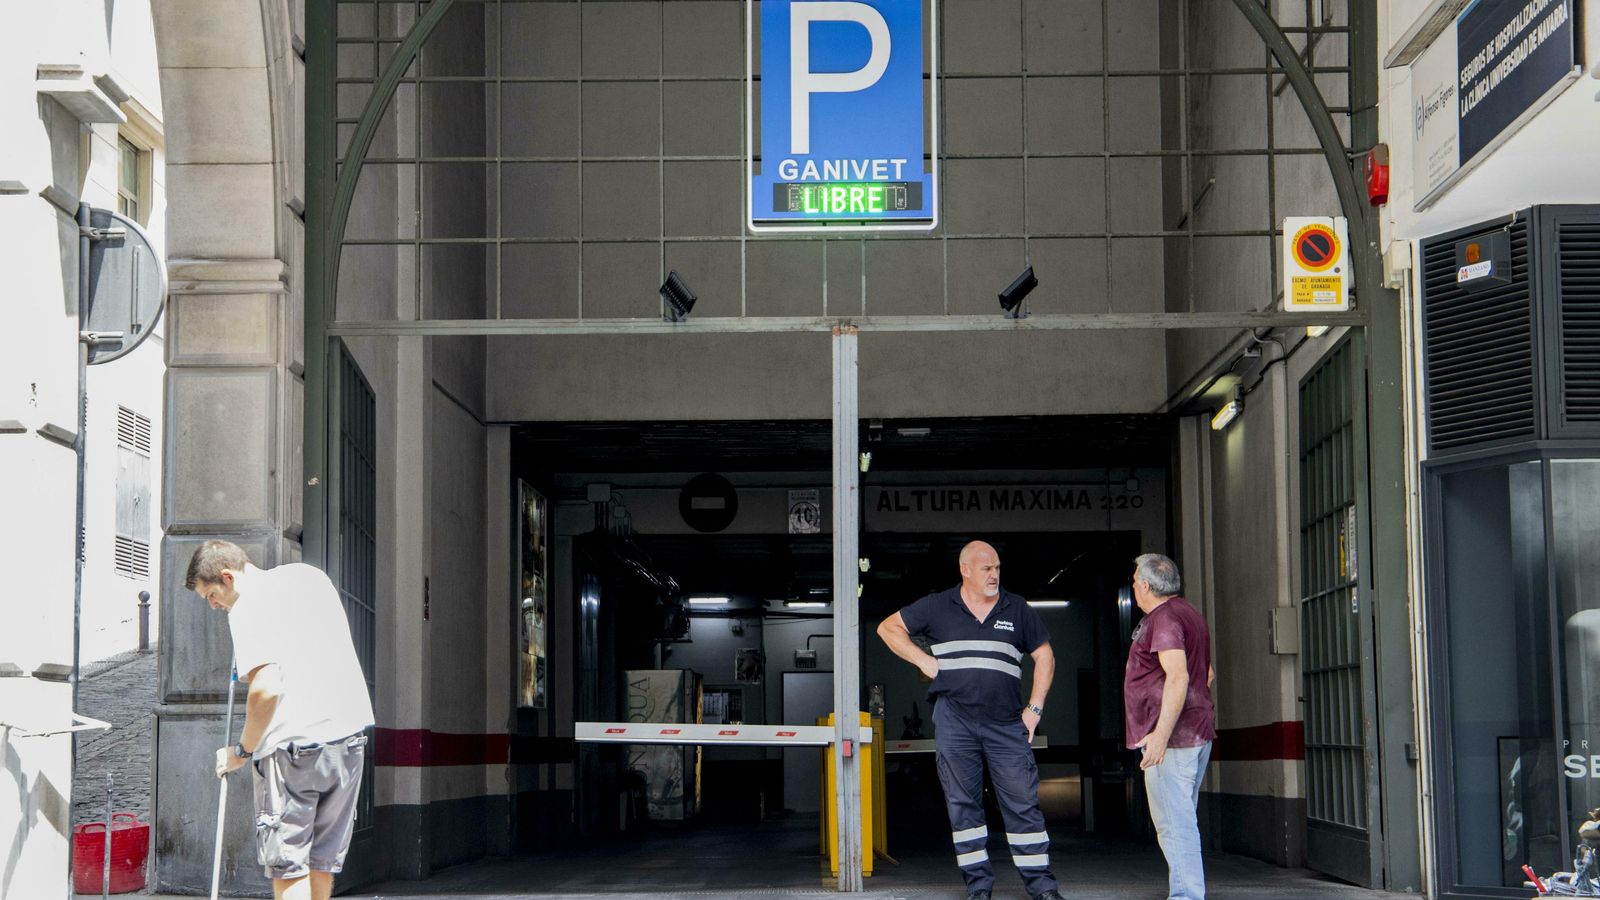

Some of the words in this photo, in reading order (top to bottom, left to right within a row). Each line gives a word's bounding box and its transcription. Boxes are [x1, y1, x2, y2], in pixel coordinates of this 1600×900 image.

[790, 1, 892, 154] P
[1461, 95, 1469, 118] LA
[1468, 74, 1490, 111] CLÍNICA
[1490, 37, 1529, 90] UNIVERSIDAD
[1528, 28, 1538, 55] DE
[1537, 0, 1568, 46] NAVARRA
[1461, 48, 1486, 89] SEGUROS
[1486, 39, 1495, 64] DE
[778, 158, 908, 181] GANIVET
[803, 186, 884, 214] LIBRE
[876, 489, 982, 512] ALTURA
[989, 489, 1093, 511] MAXIMA
[1100, 495, 1144, 509] 220
